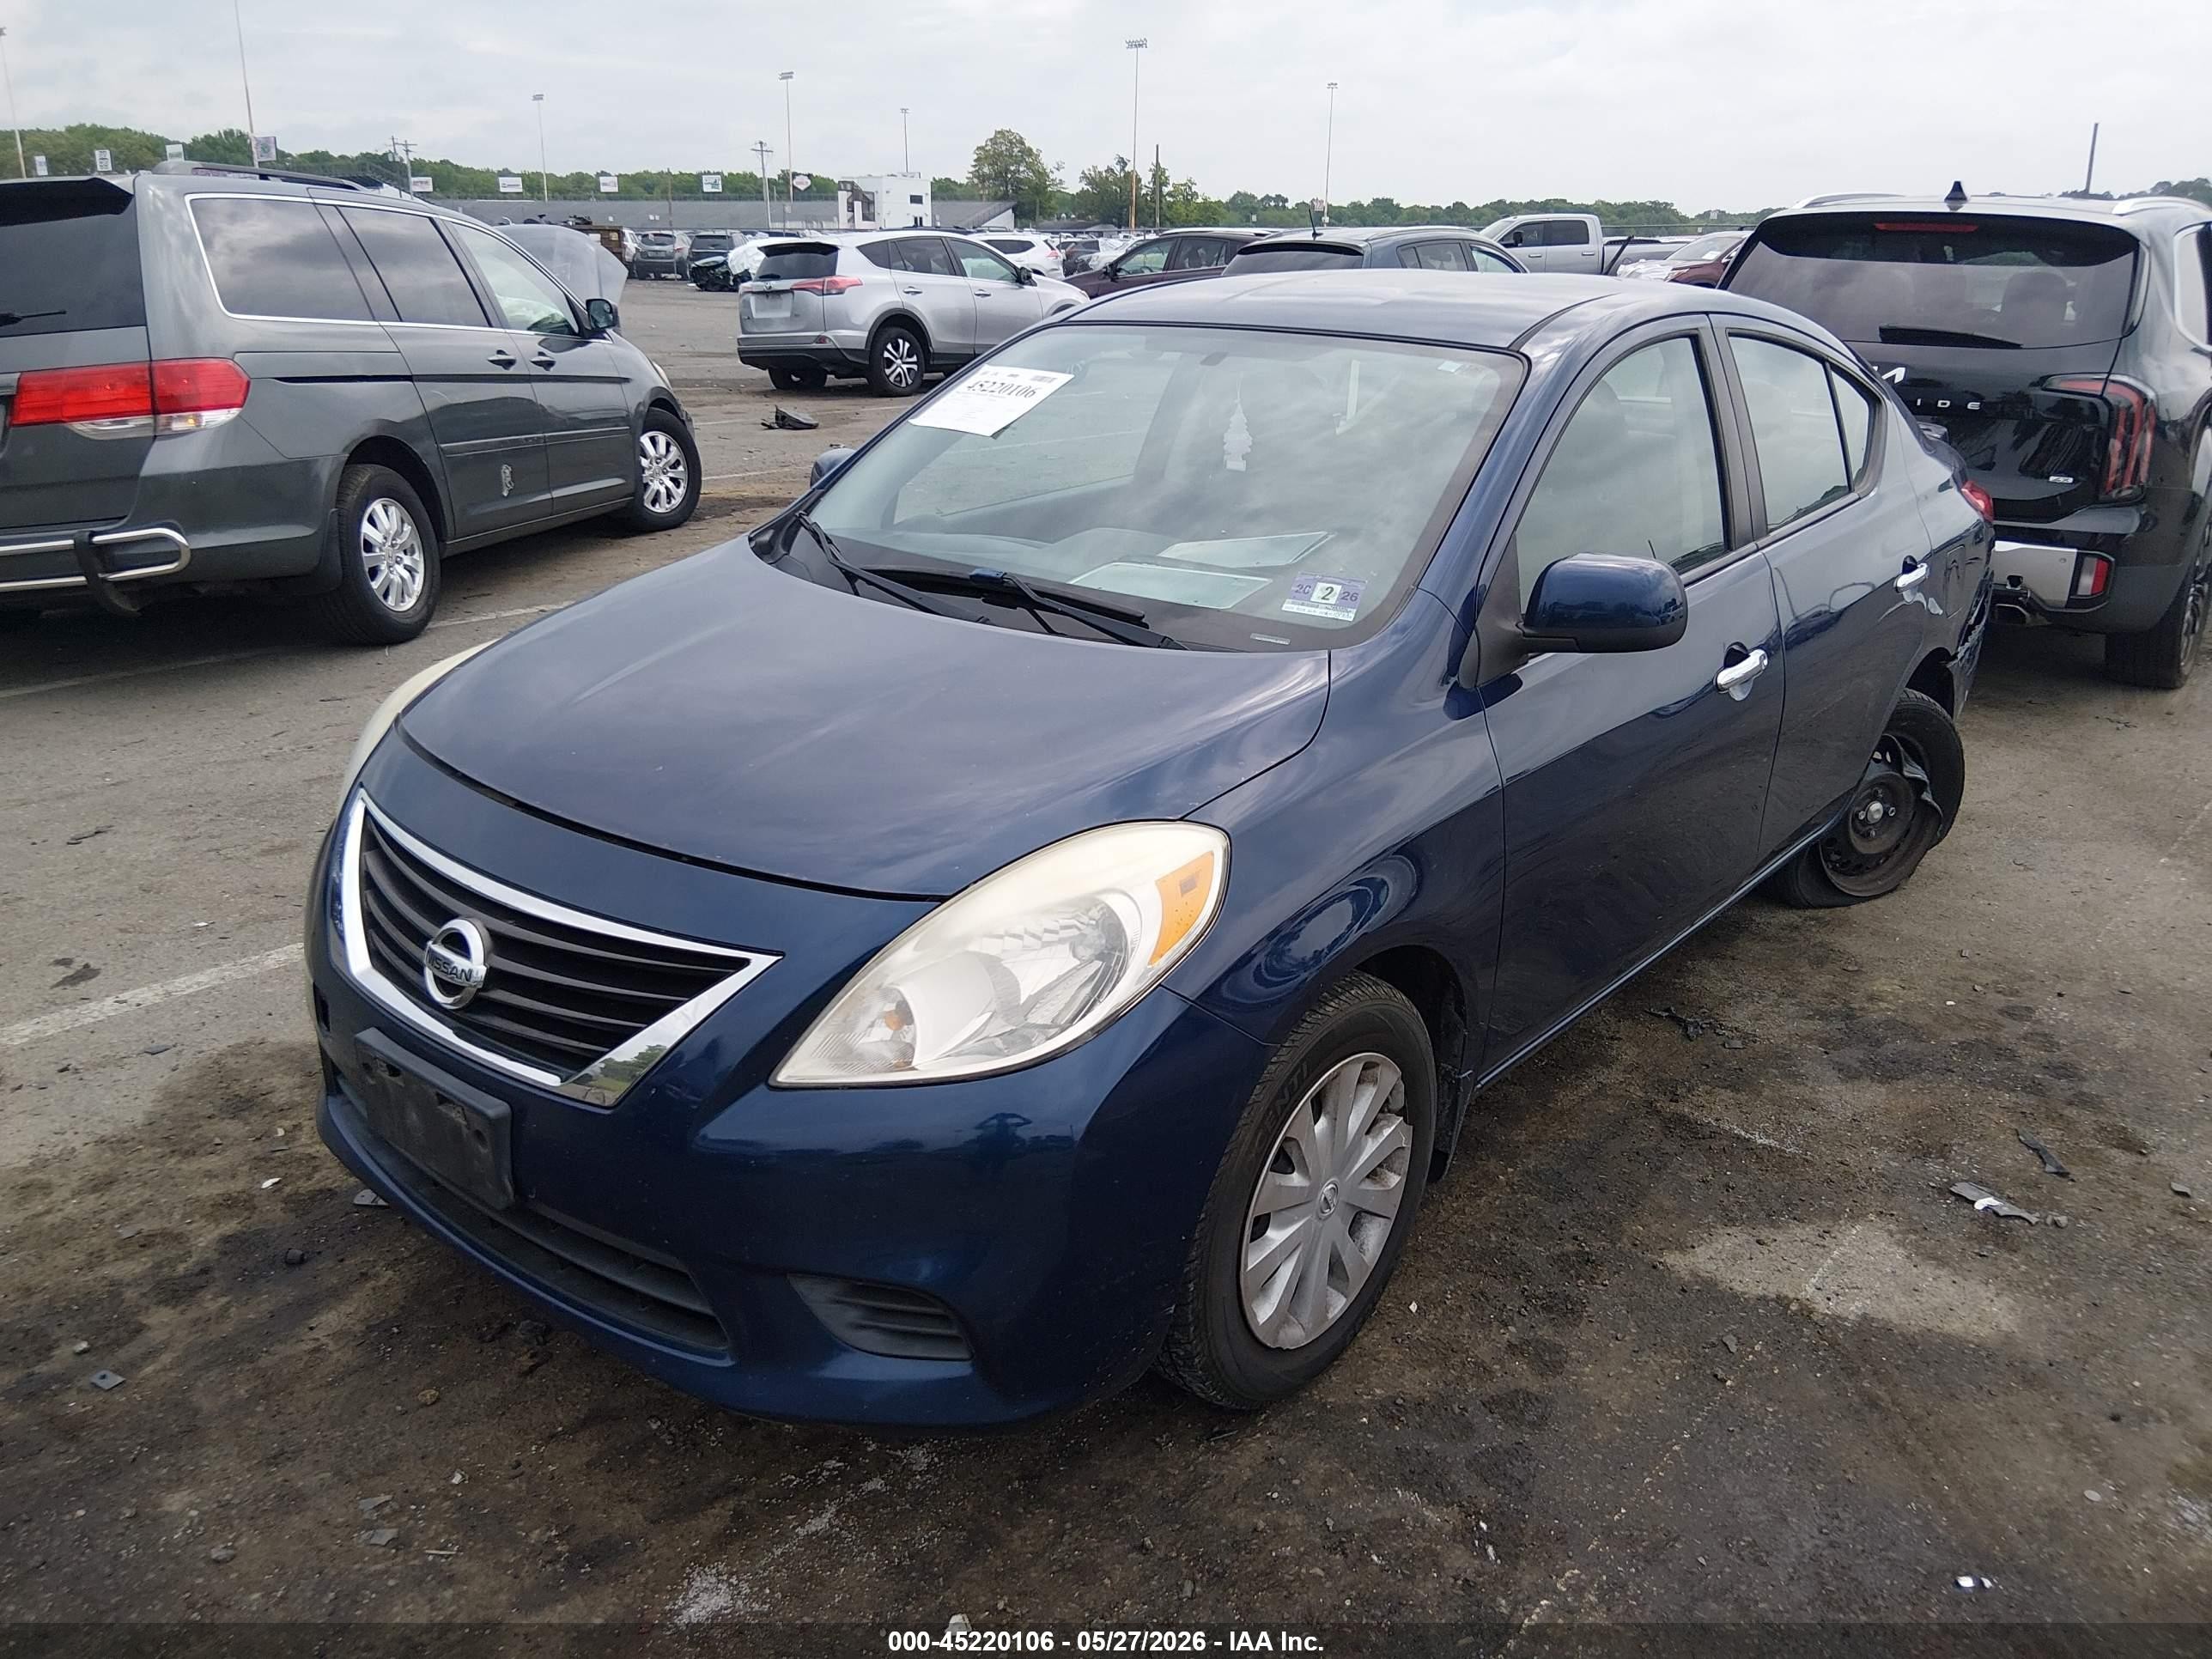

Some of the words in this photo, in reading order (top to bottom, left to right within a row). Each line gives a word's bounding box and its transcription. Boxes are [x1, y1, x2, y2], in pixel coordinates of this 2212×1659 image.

[967, 380, 1040, 398] 45220106
[1321, 586, 1334, 600] 2
[1340, 591, 1359, 602] 26
[428, 951, 473, 982] NISSAN
